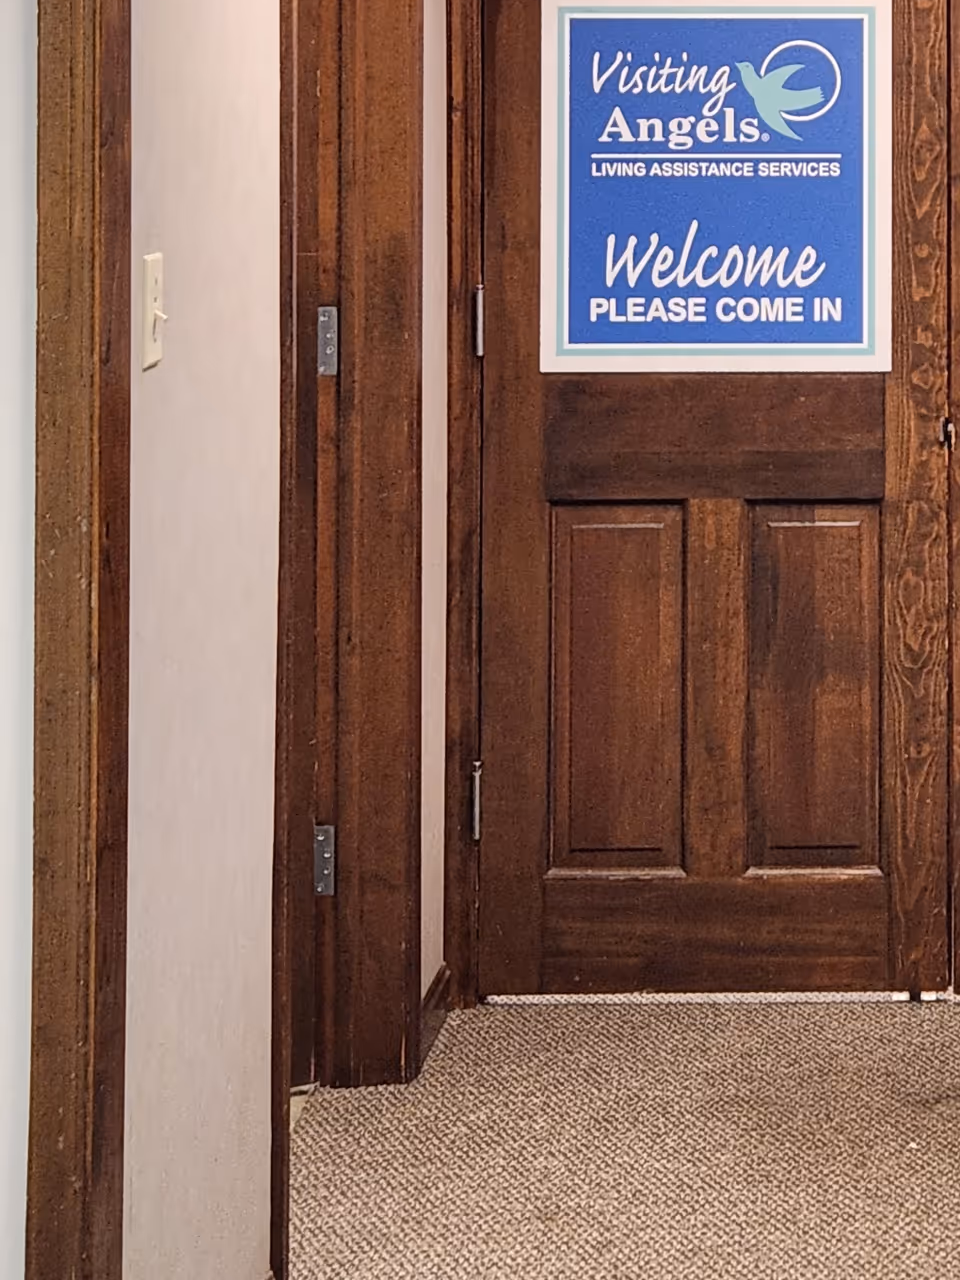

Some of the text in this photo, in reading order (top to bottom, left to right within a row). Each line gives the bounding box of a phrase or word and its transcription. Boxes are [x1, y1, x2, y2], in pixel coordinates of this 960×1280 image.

[591, 50, 737, 117] Visiting
[591, 162, 841, 178] LIVING ASSISTANCE SERVICES
[605, 219, 826, 289] Welcome
[589, 296, 842, 323] PLEASE COME IN
